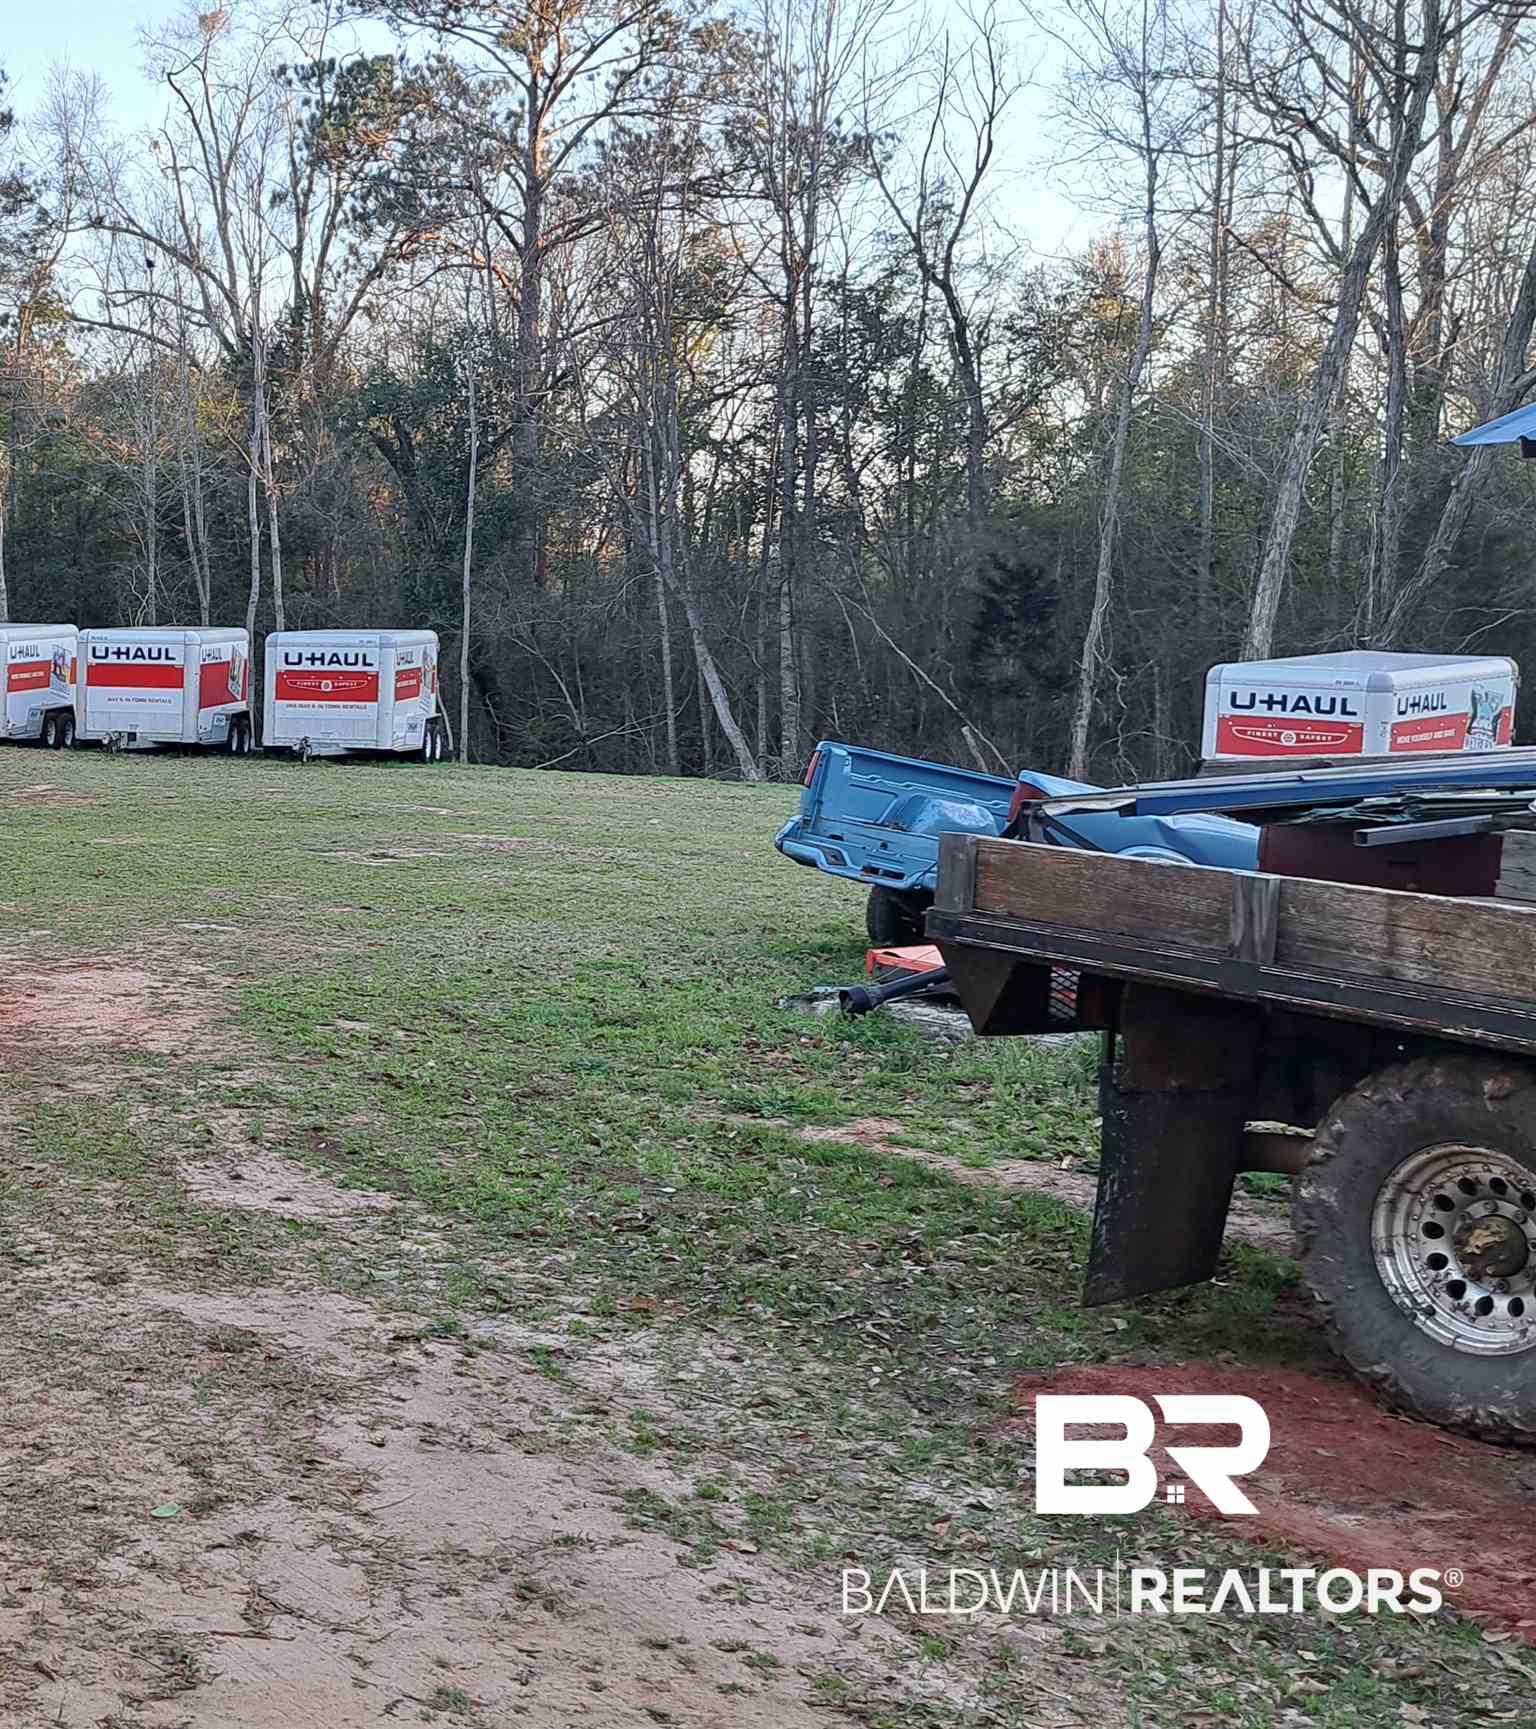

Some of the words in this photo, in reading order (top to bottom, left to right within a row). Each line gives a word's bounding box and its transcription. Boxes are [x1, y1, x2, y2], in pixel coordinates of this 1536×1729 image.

[92, 646, 177, 661] U-HAUL
[284, 652, 374, 667] U-HAUL
[1230, 691, 1358, 717] U-HAUL
[1397, 692, 1447, 716] U-HAUL
[1247, 730, 1279, 738] FINEST
[1299, 734, 1333, 742] SAFEST
